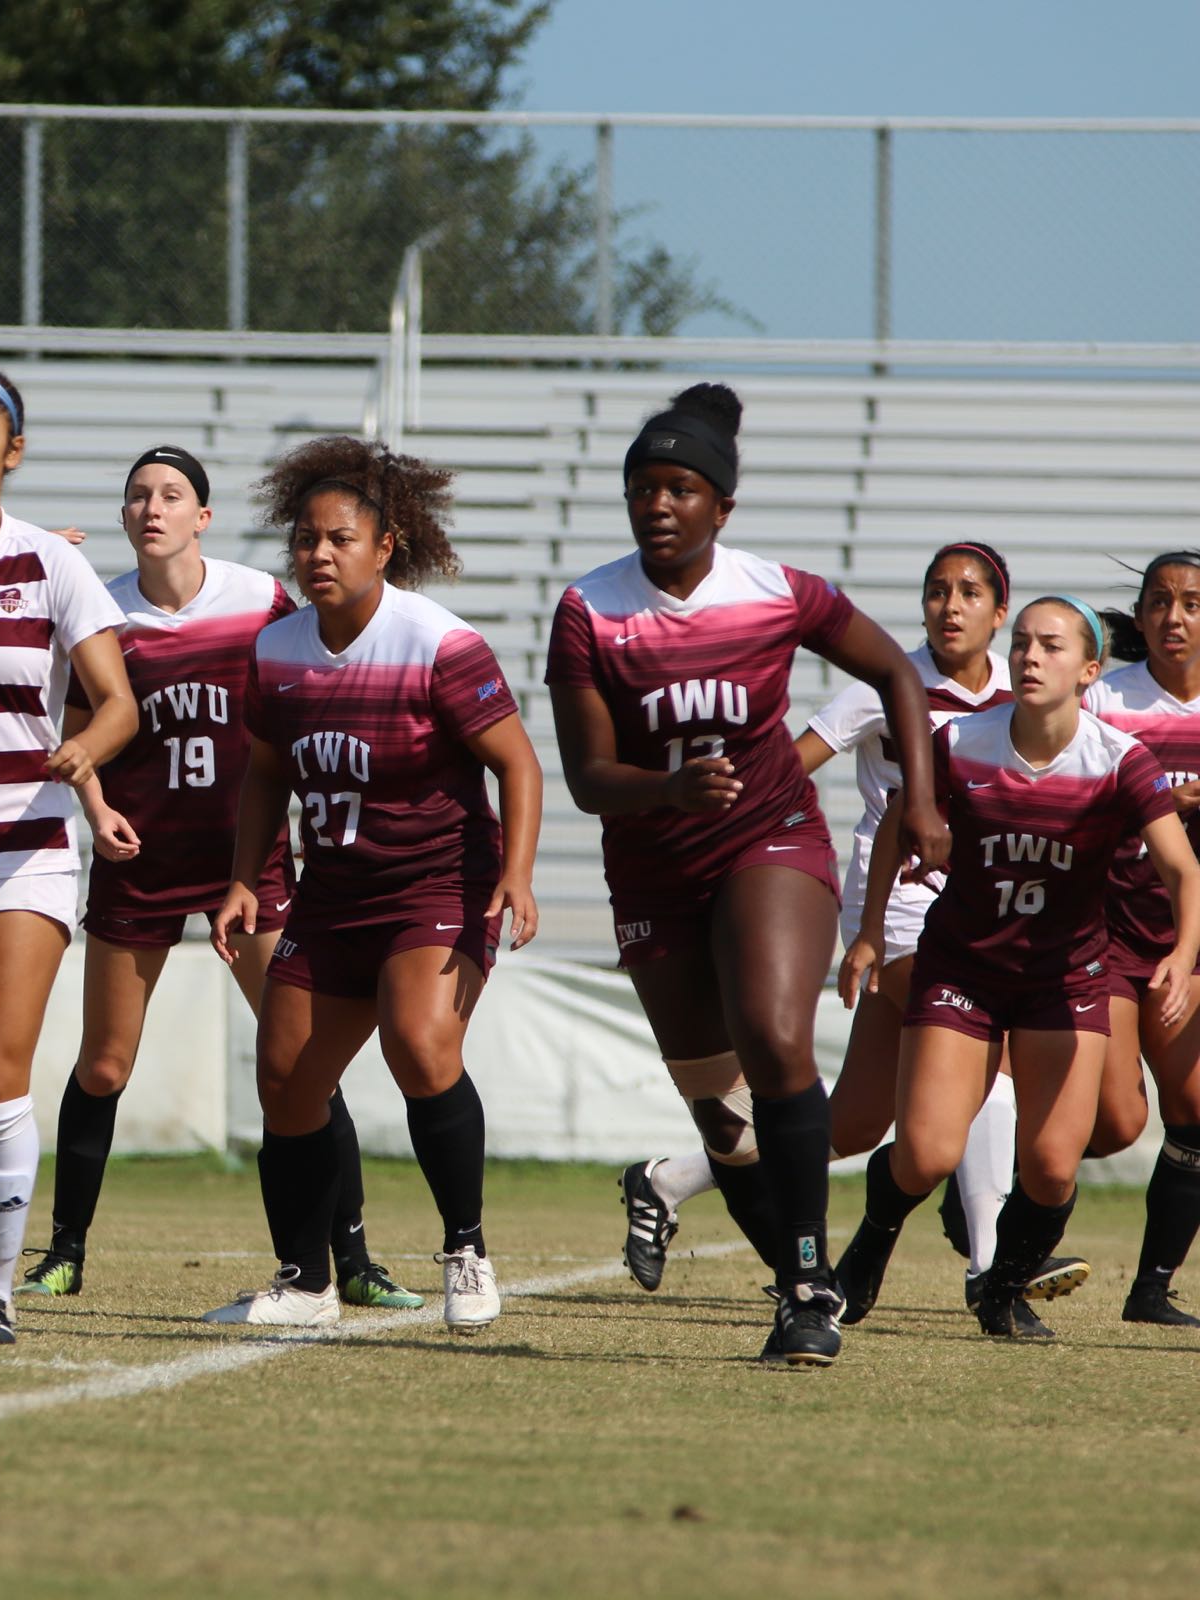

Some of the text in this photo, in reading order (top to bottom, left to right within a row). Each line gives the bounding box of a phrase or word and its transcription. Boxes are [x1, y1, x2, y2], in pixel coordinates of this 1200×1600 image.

[141, 682, 229, 734] TWU
[640, 678, 749, 733] TWU
[163, 735, 216, 790] 19
[291, 731, 371, 783] TWU
[304, 791, 362, 847] 27
[979, 833, 1074, 872] TWU
[994, 878, 1047, 919] 16
[941, 988, 974, 1012] TWU
